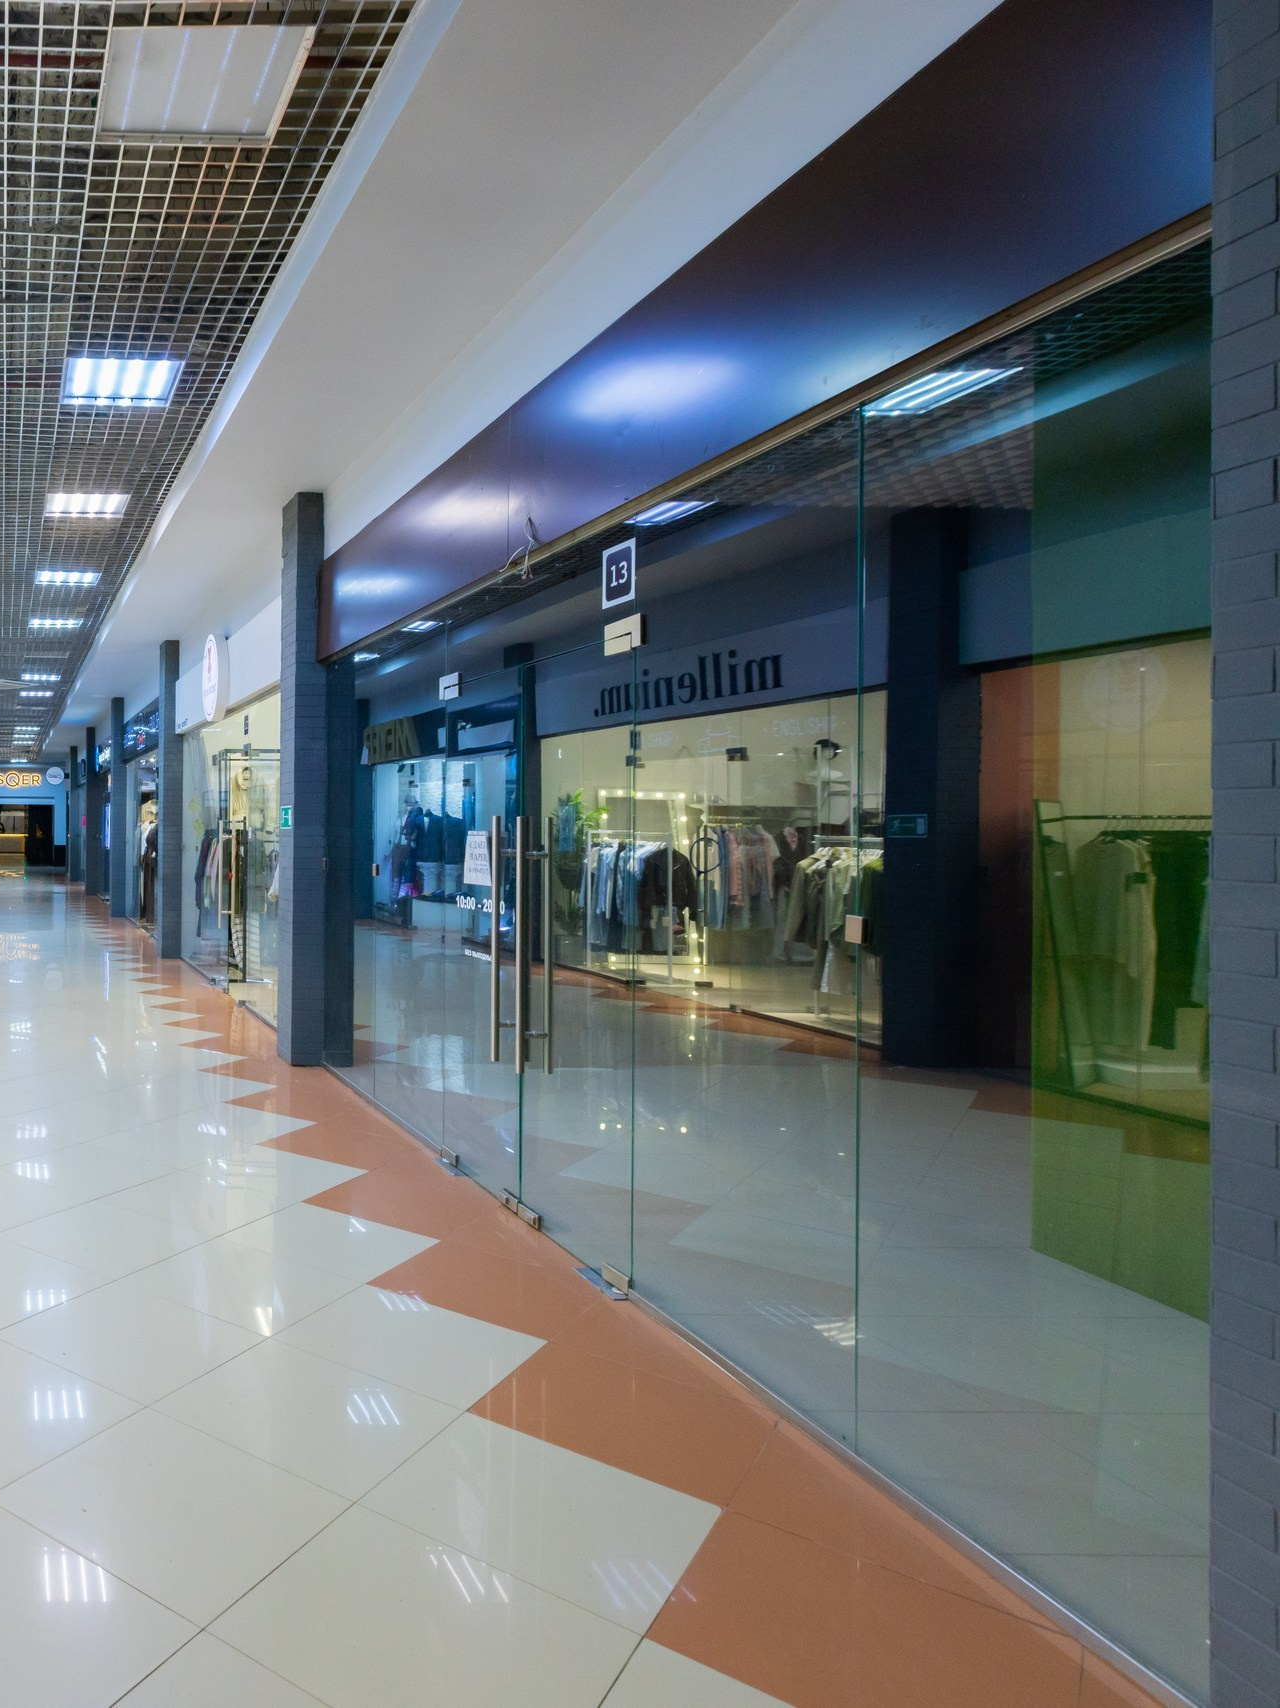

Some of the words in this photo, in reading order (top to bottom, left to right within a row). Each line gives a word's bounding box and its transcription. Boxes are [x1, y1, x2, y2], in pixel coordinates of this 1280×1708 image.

[609, 560, 629, 588] 13
[456, 894, 476, 910] 10:00
[482, 898, 505, 915] 200
